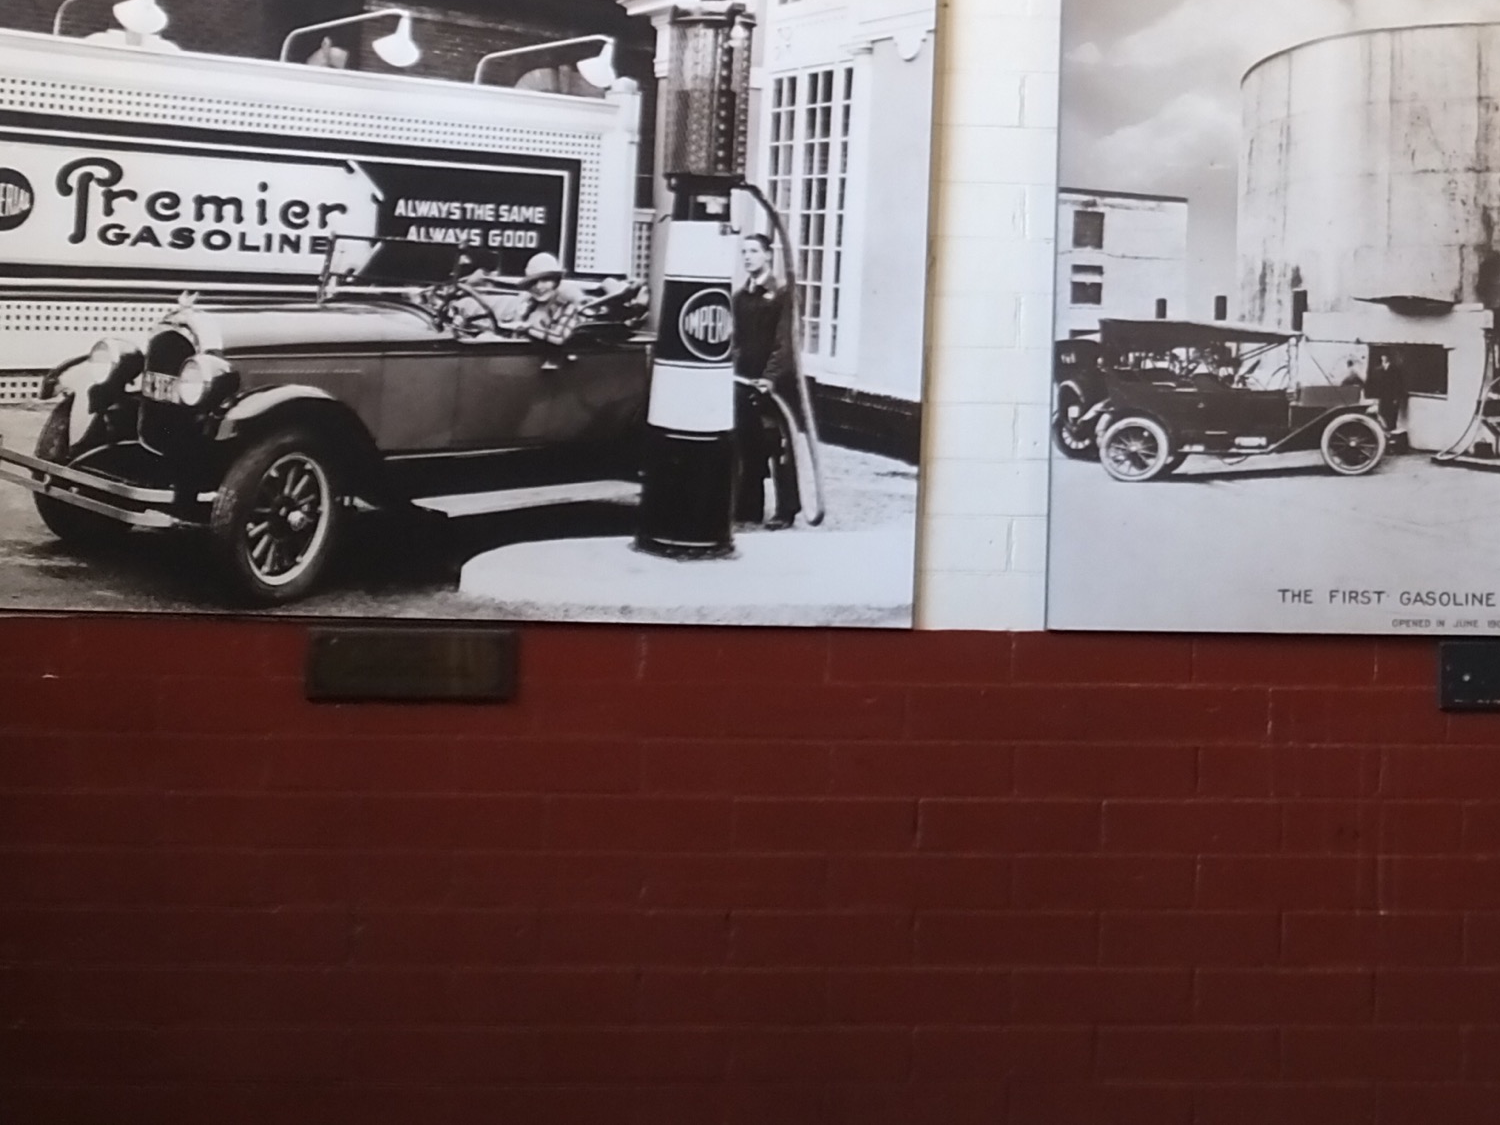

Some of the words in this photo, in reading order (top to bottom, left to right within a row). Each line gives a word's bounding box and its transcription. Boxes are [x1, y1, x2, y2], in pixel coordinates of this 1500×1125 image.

[54, 156, 348, 245] Premier
[394, 198, 461, 221] ALWAYS
[461, 202, 496, 223] THE
[498, 205, 546, 225] SAME
[97, 222, 332, 256] GASOLINE
[406, 226, 483, 249] ALWAYS
[486, 228, 539, 250] GOOD
[1278, 588, 1314, 604] THE
[1329, 589, 1386, 606] FIRST
[1400, 591, 1496, 607] GASOLINE
[1391, 618, 1431, 628] OPENED
[1435, 618, 1446, 628] IN
[1452, 619, 1479, 629] JUNE
